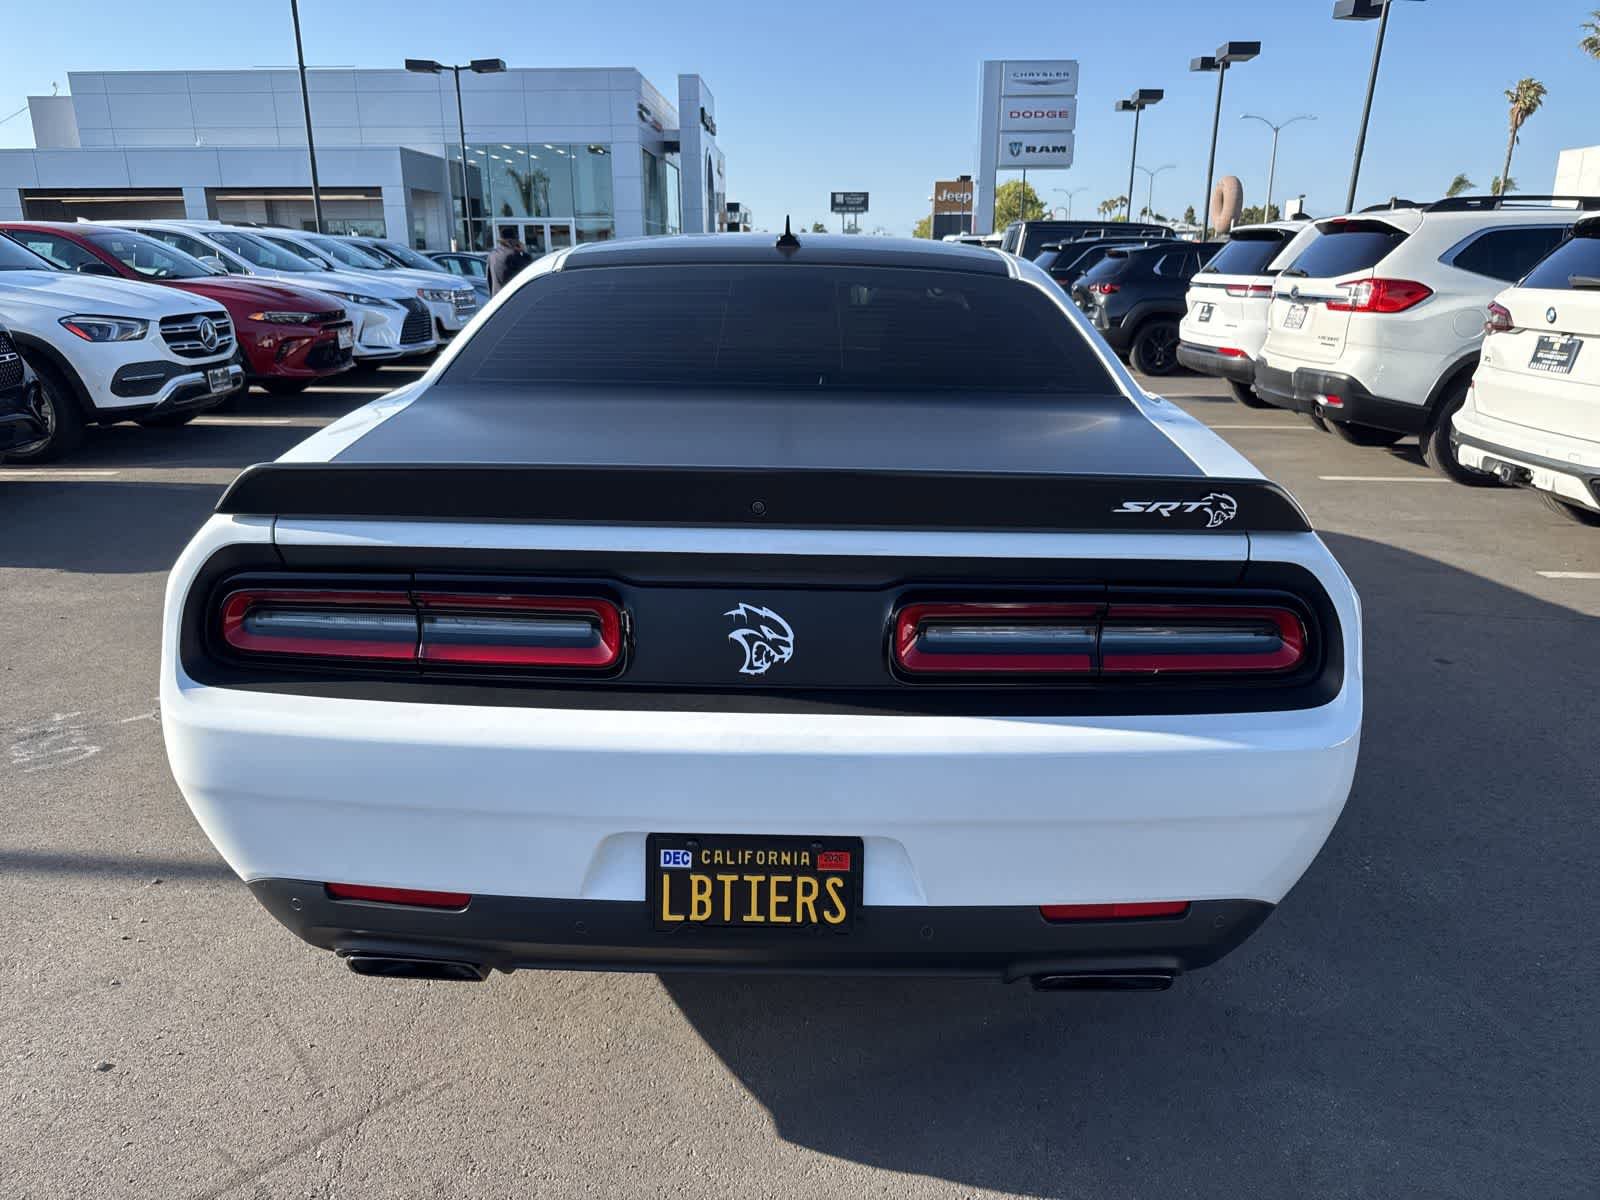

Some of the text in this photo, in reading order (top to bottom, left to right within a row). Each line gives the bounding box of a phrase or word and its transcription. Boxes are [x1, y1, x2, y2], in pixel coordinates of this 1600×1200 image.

[1009, 111, 1069, 119] DODGE
[1025, 145, 1067, 153] RAM
[937, 189, 972, 203] Jeep
[1112, 501, 1212, 517] SRT
[663, 851, 690, 866] DEC
[701, 850, 811, 866] CALIFORNIA
[662, 873, 847, 924] LBTIERS
